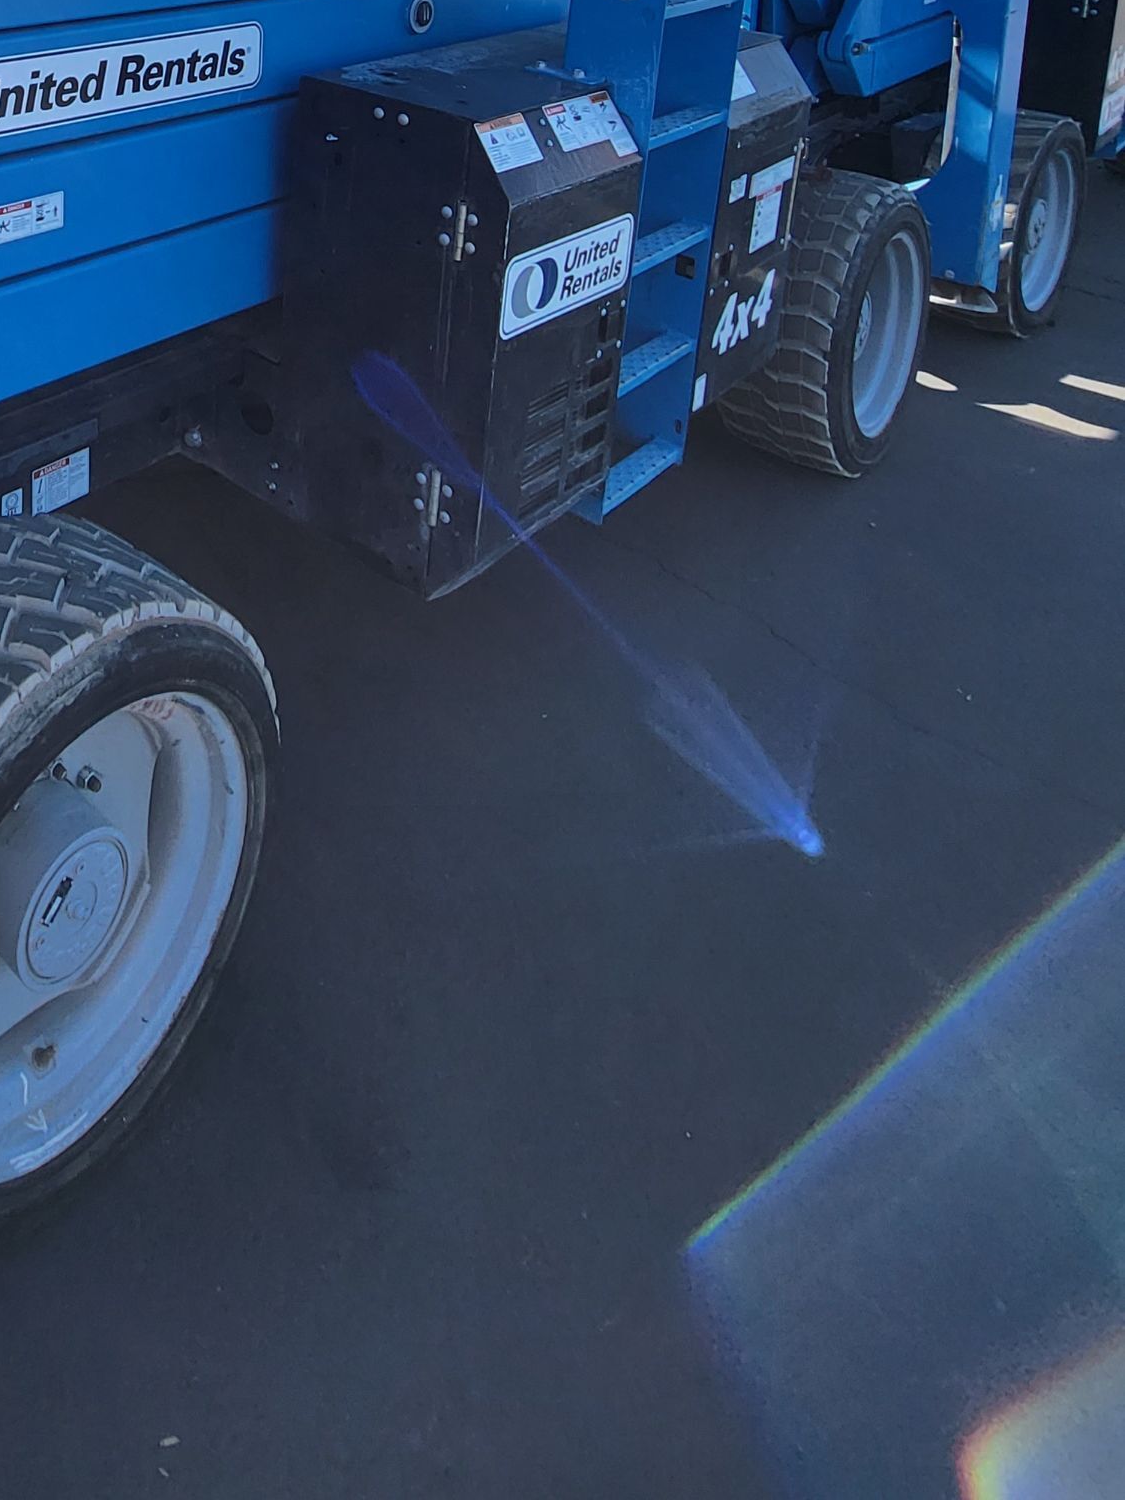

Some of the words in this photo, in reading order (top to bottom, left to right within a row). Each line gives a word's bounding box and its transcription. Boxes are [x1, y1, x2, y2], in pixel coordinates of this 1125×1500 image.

[116, 40, 247, 96] Rentals
[564, 230, 622, 273] United
[560, 257, 622, 301] Rentals
[711, 268, 776, 356] 4x4
